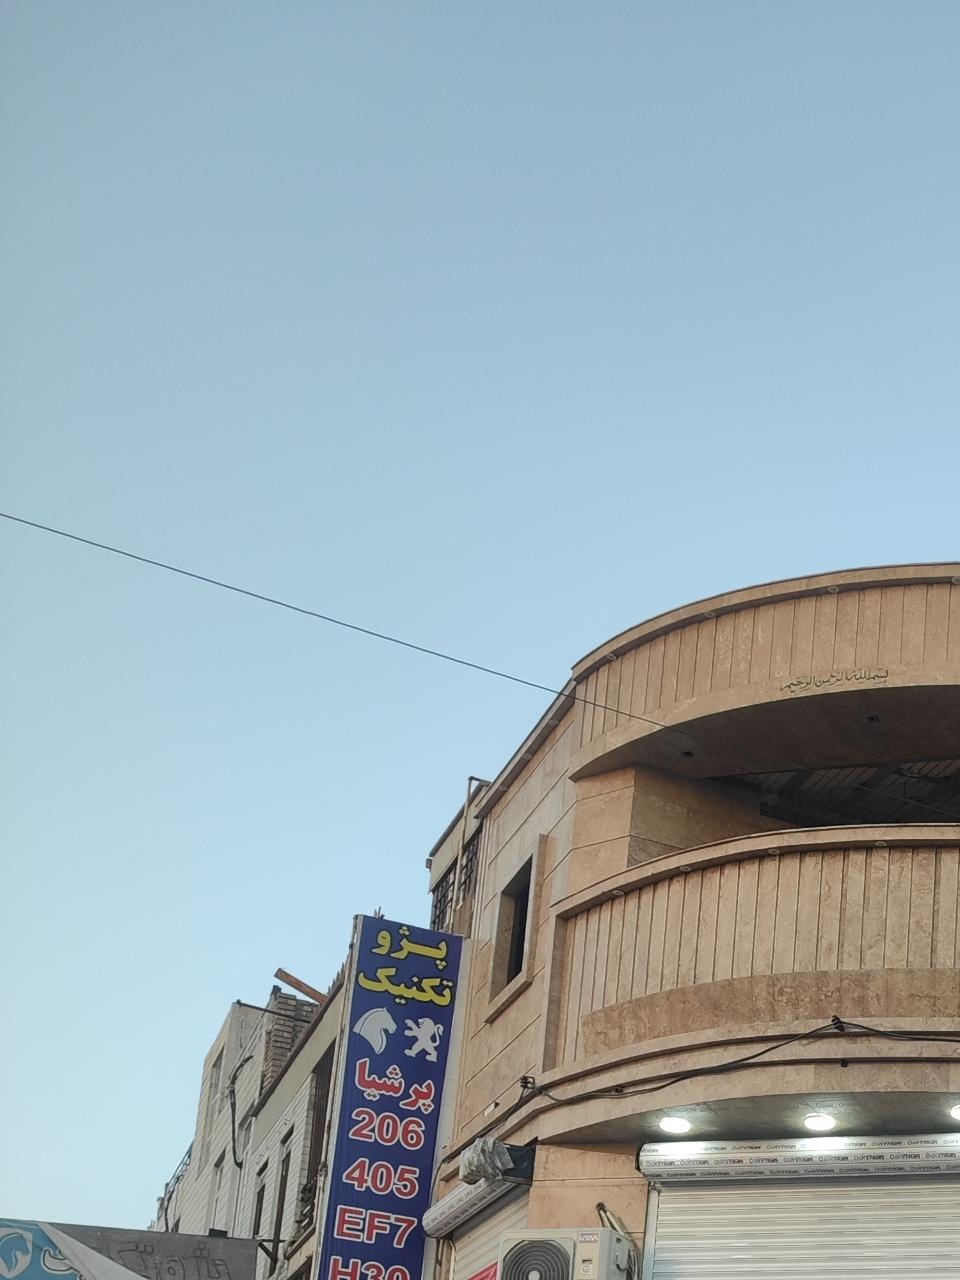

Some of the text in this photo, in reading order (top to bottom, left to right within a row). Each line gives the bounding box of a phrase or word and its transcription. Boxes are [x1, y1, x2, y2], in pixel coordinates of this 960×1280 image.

[371, 925, 448, 970] پژو
[357, 967, 453, 1006] تکنیک
[355, 1057, 436, 1115] پرشیا
[349, 1107, 426, 1151] 206
[342, 1157, 420, 1200] 405
[333, 1204, 417, 1249] EF7
